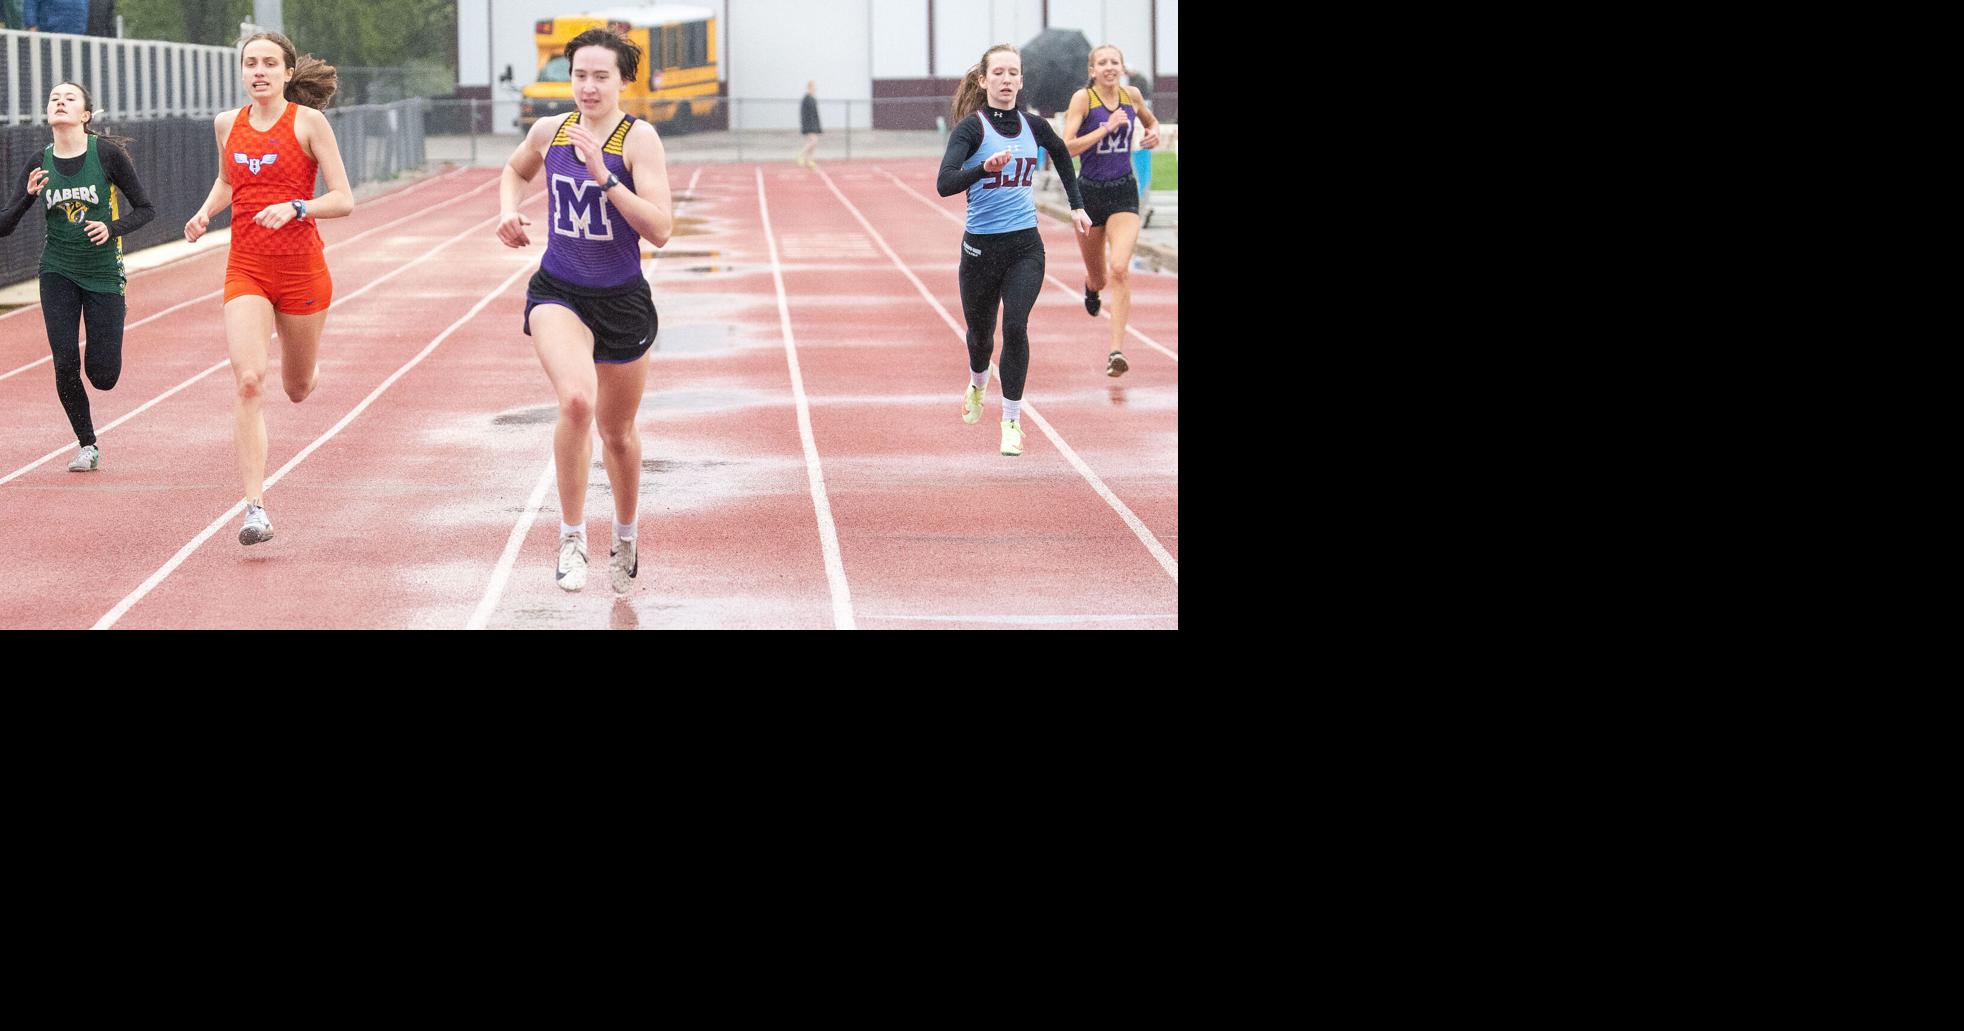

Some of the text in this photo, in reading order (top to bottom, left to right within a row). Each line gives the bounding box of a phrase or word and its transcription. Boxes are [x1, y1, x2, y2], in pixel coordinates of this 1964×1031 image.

[1096, 121, 1132, 154] M
[45, 184, 99, 210] SABERS
[552, 173, 614, 240] M
